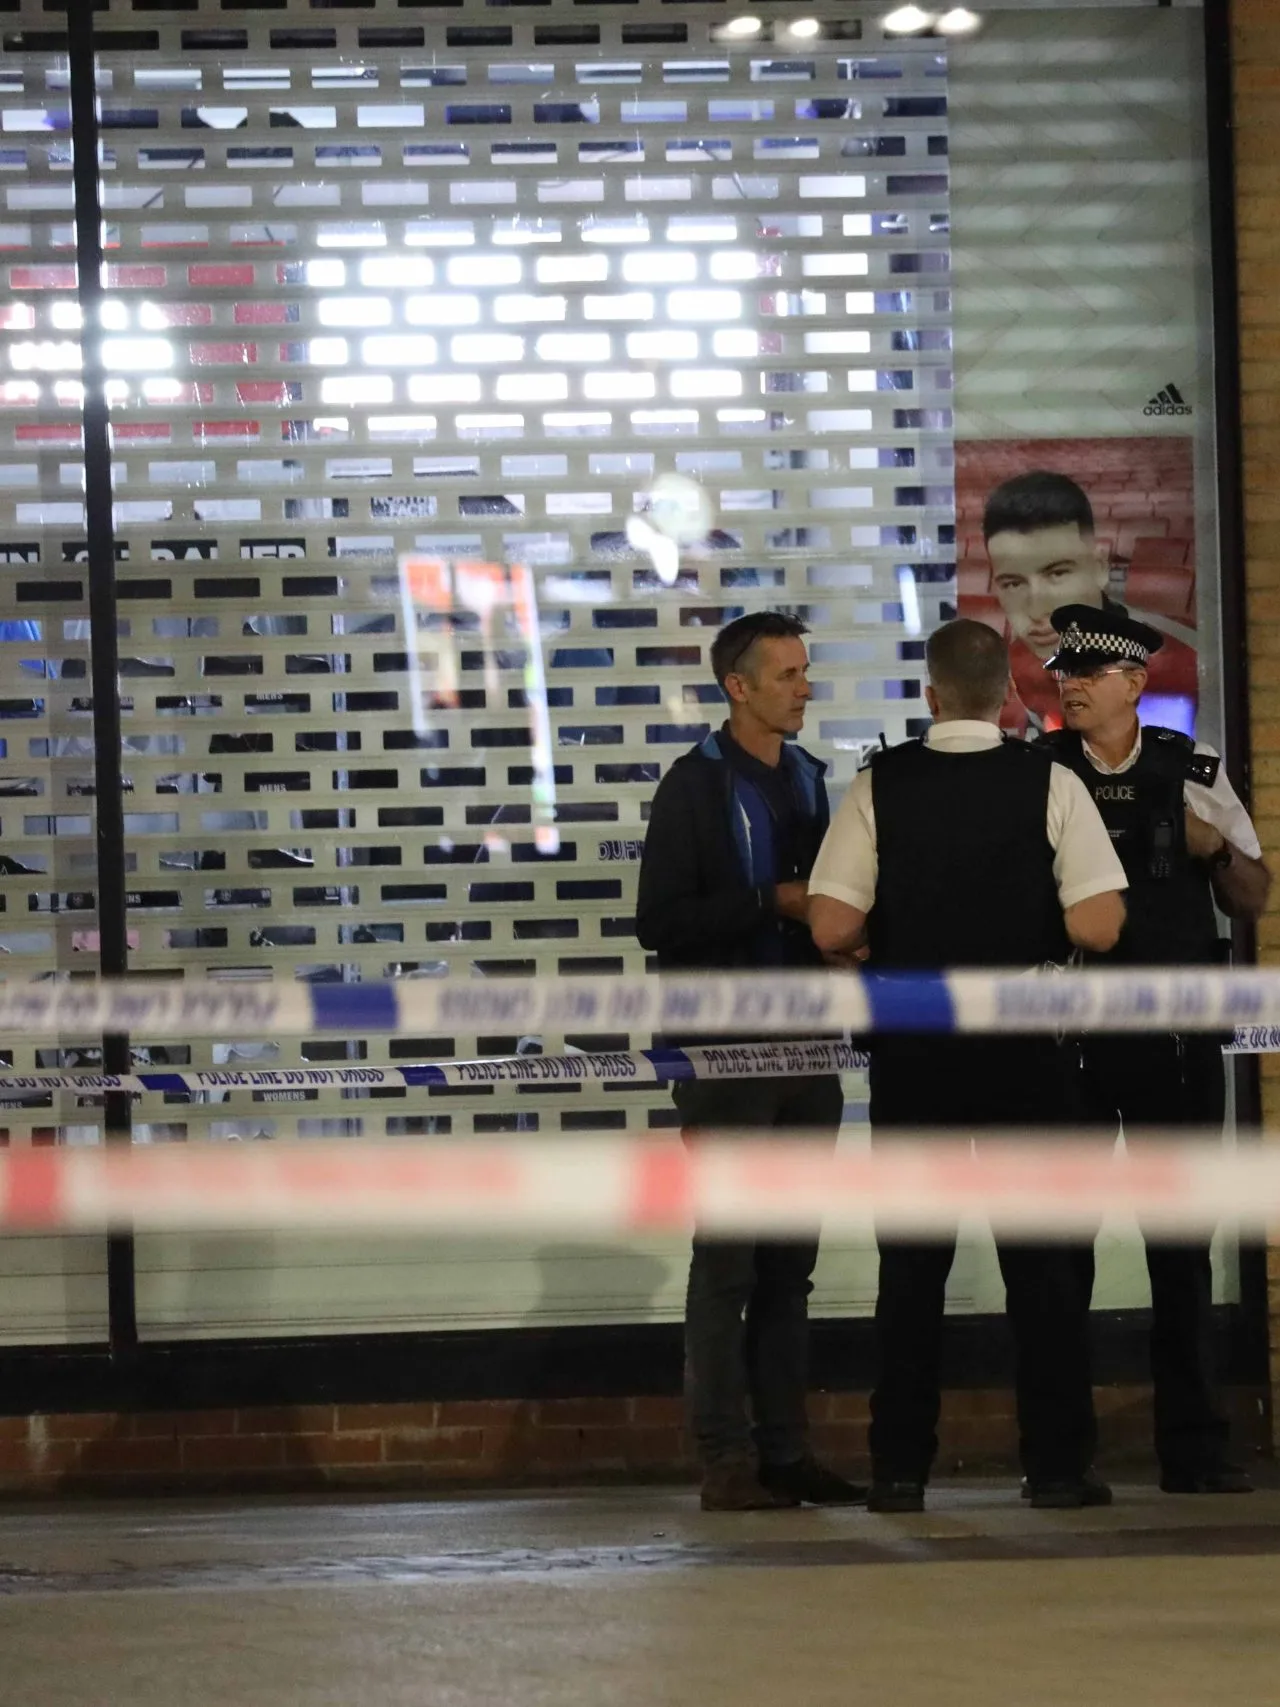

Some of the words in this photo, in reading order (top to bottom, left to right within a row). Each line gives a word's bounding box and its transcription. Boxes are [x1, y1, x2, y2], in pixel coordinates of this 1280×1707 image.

[1143, 404, 1192, 416] adidas
[259, 783, 286, 793] MENS
[1095, 785, 1136, 801] POLICE
[1250, 1027, 1268, 1048] DO
[506, 1060, 538, 1079] LINE
[540, 1057, 560, 1079] DO
[560, 1055, 588, 1078] NOT
[588, 1053, 637, 1077] CROSS
[703, 1049, 752, 1074] POLICE
[804, 1045, 832, 1069] NOT
[834, 1043, 871, 1069] CROS
[264, 1090, 306, 1102] WOMENS
